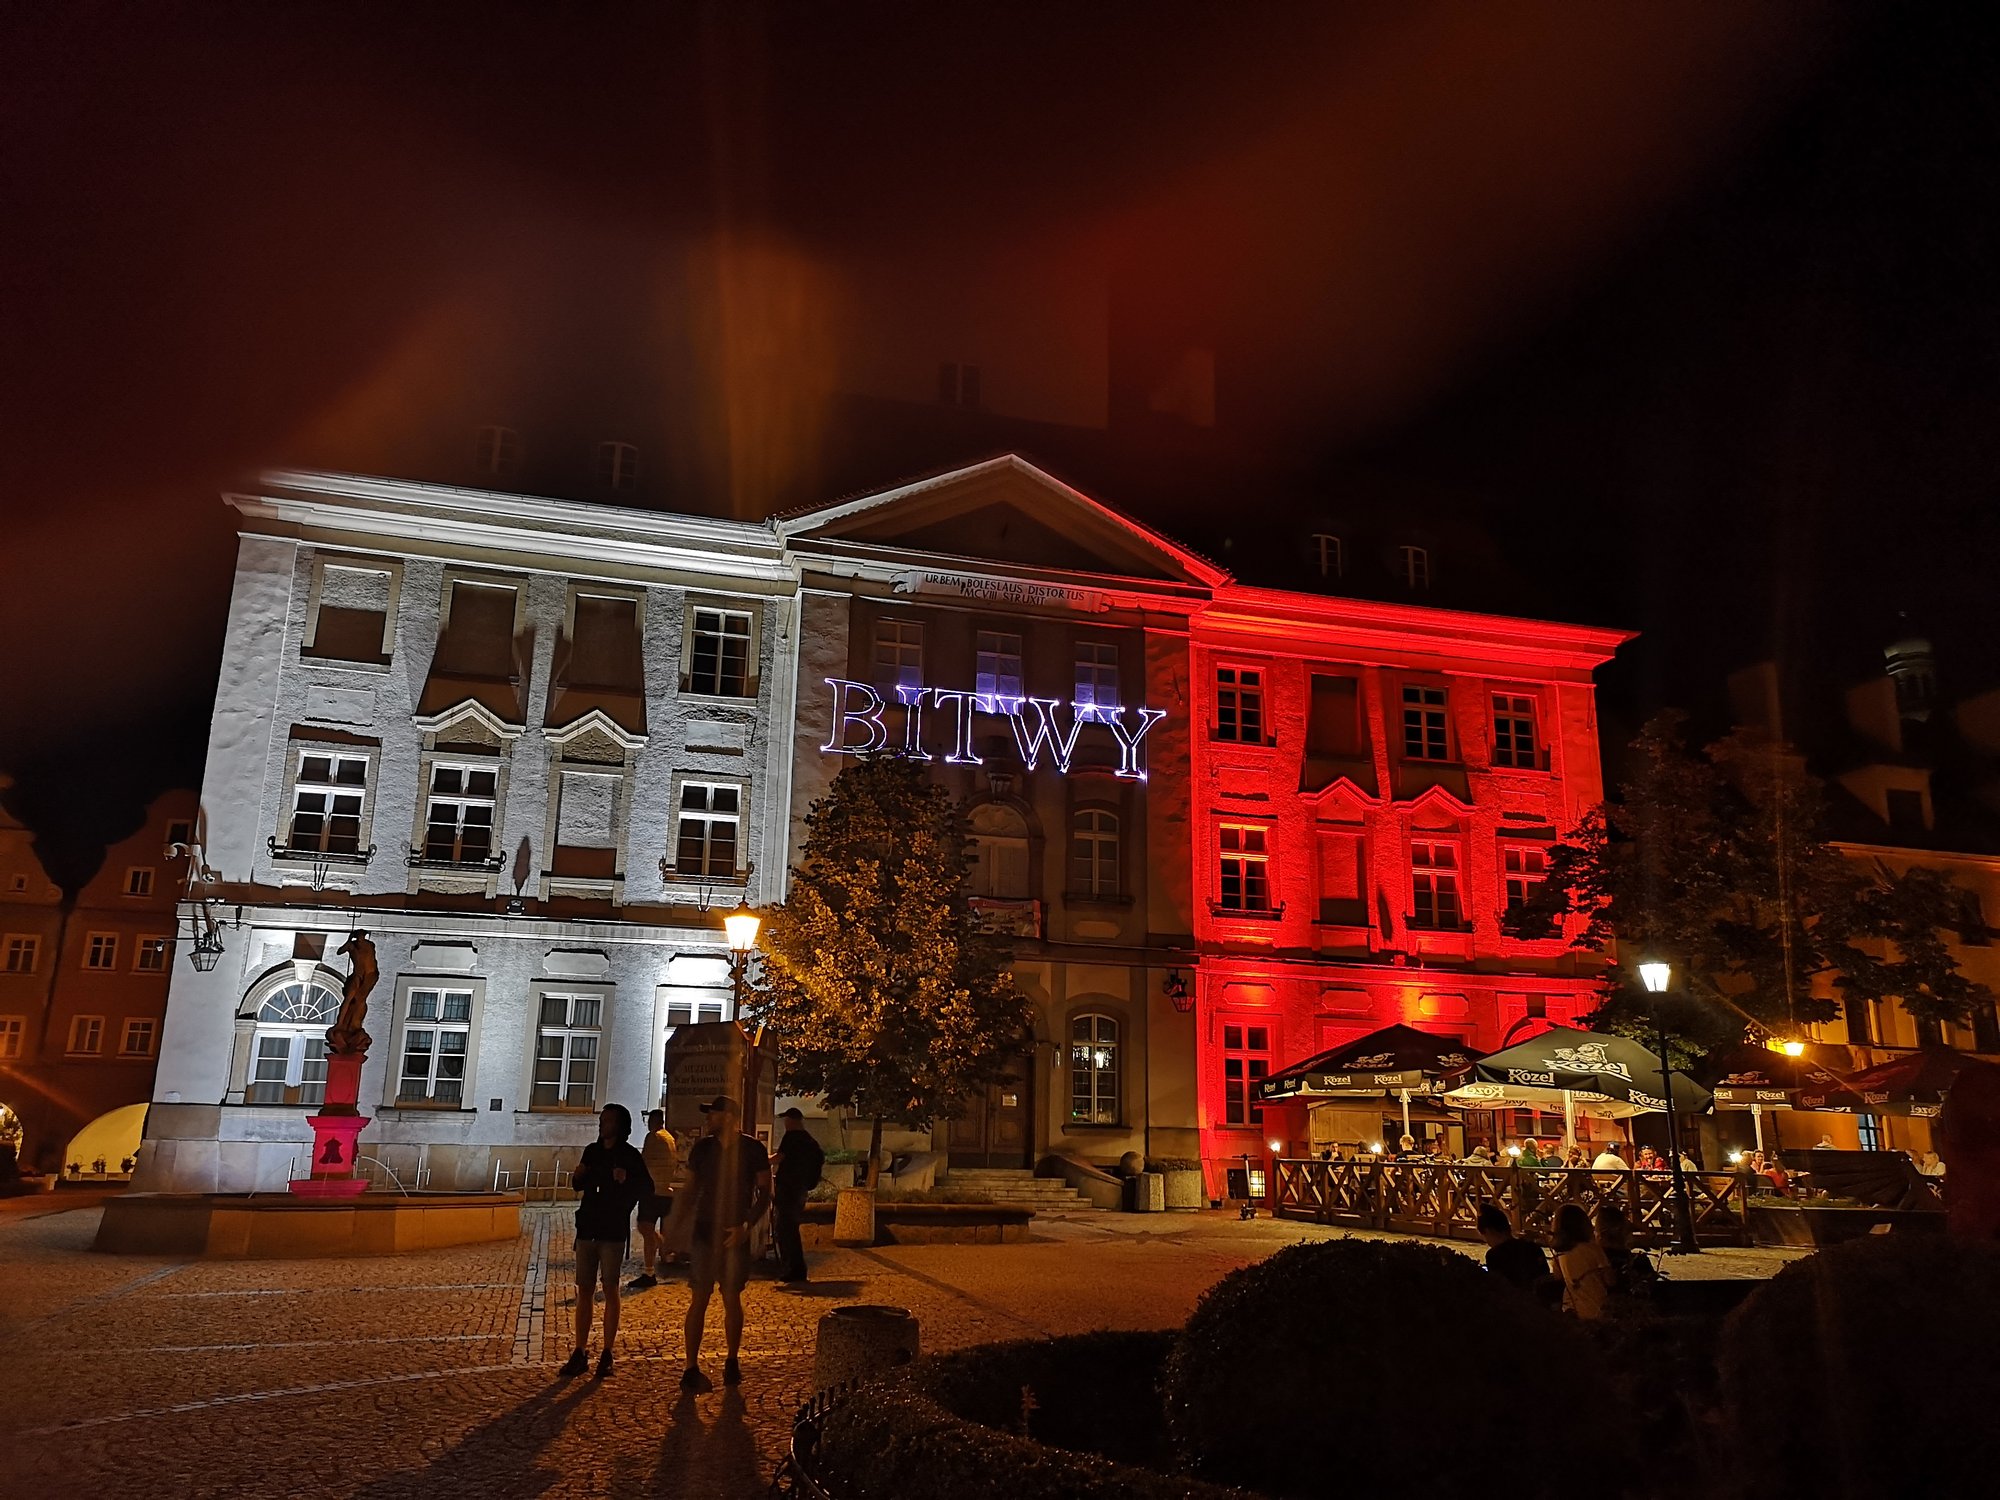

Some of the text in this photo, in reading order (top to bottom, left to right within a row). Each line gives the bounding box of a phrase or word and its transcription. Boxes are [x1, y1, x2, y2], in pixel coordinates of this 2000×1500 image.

[925, 573, 1085, 601] URBEM BOLESLAUS DISTORTUS
[964, 587, 1046, 606] MCVIII STRUXIT
[820, 677, 1168, 782] BITWY
[1508, 1068, 1555, 1086] Kozel
[1542, 1059, 1633, 1082] Kozel
[1323, 1074, 1403, 1086] Kozel Kozel
[1714, 1091, 1785, 1101] ozel Kozel
[1802, 1091, 1890, 1107] Kozel Kozel
